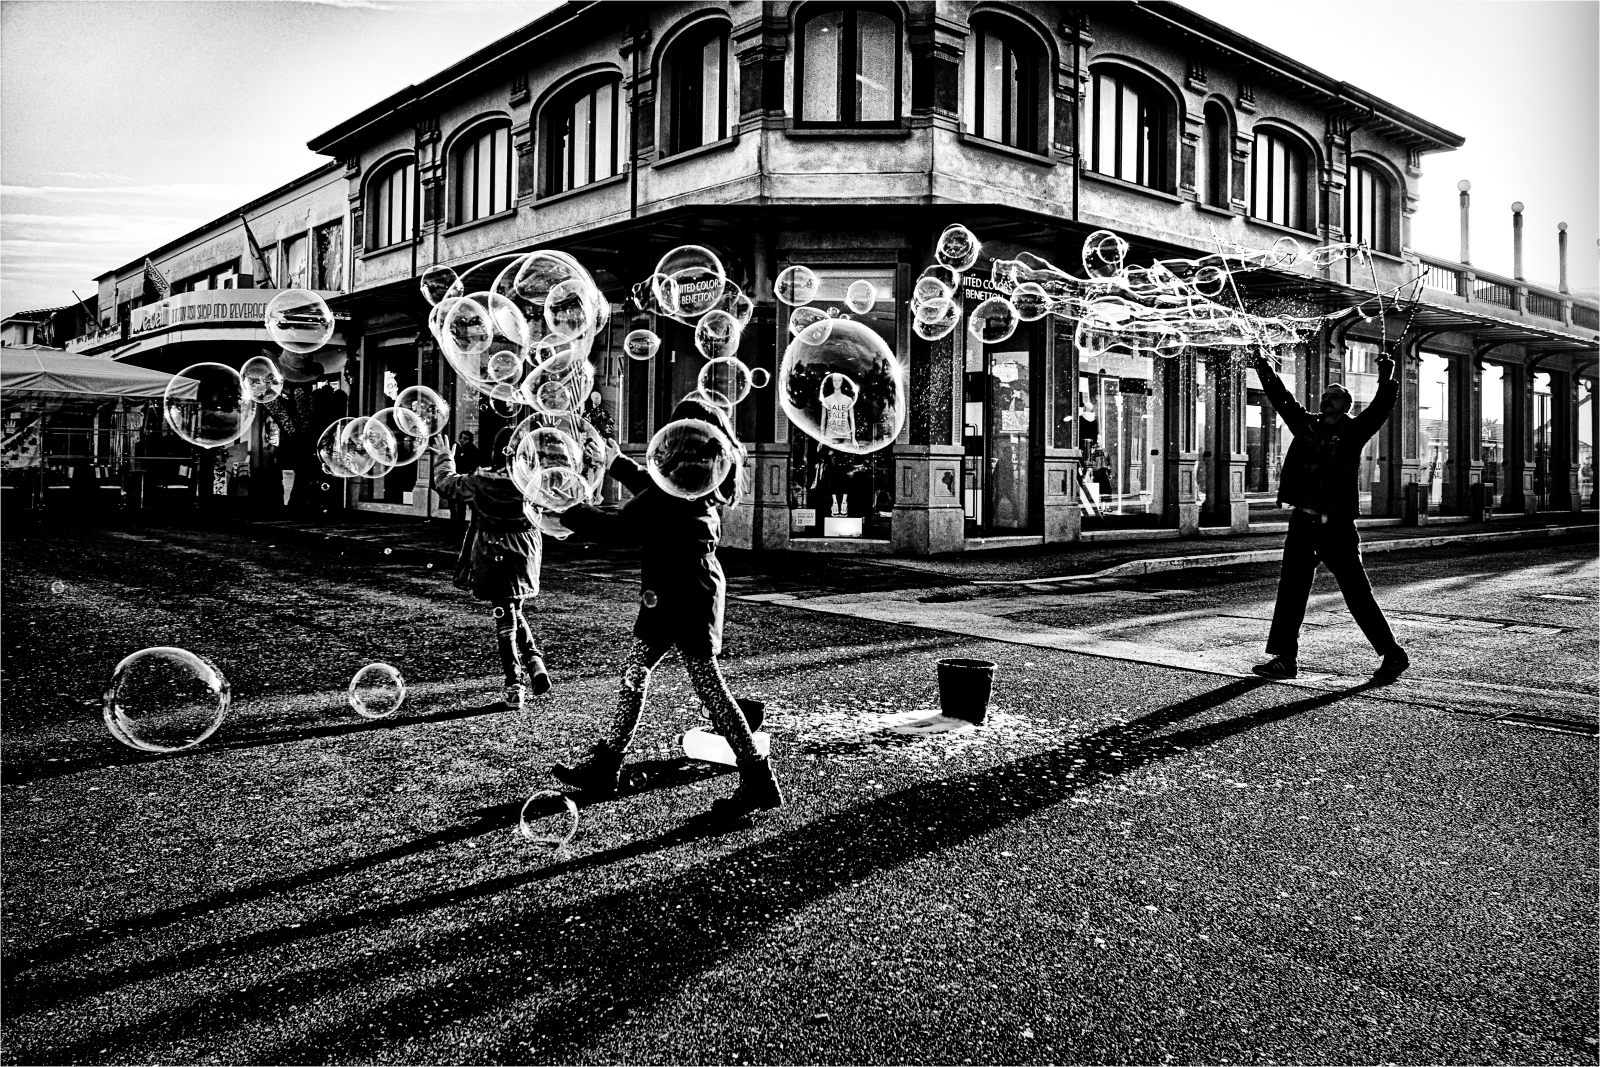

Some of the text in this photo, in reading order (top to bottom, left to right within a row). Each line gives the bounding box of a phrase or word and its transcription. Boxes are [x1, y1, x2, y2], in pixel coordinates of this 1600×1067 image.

[696, 278, 722, 291] COLORS
[983, 279, 1013, 293] COLORS
[681, 291, 715, 305] BENETTON
[197, 302, 212, 321] SHOP
[213, 302, 227, 319] AND
[828, 411, 846, 420] SALE
[828, 420, 846, 428] SALE
